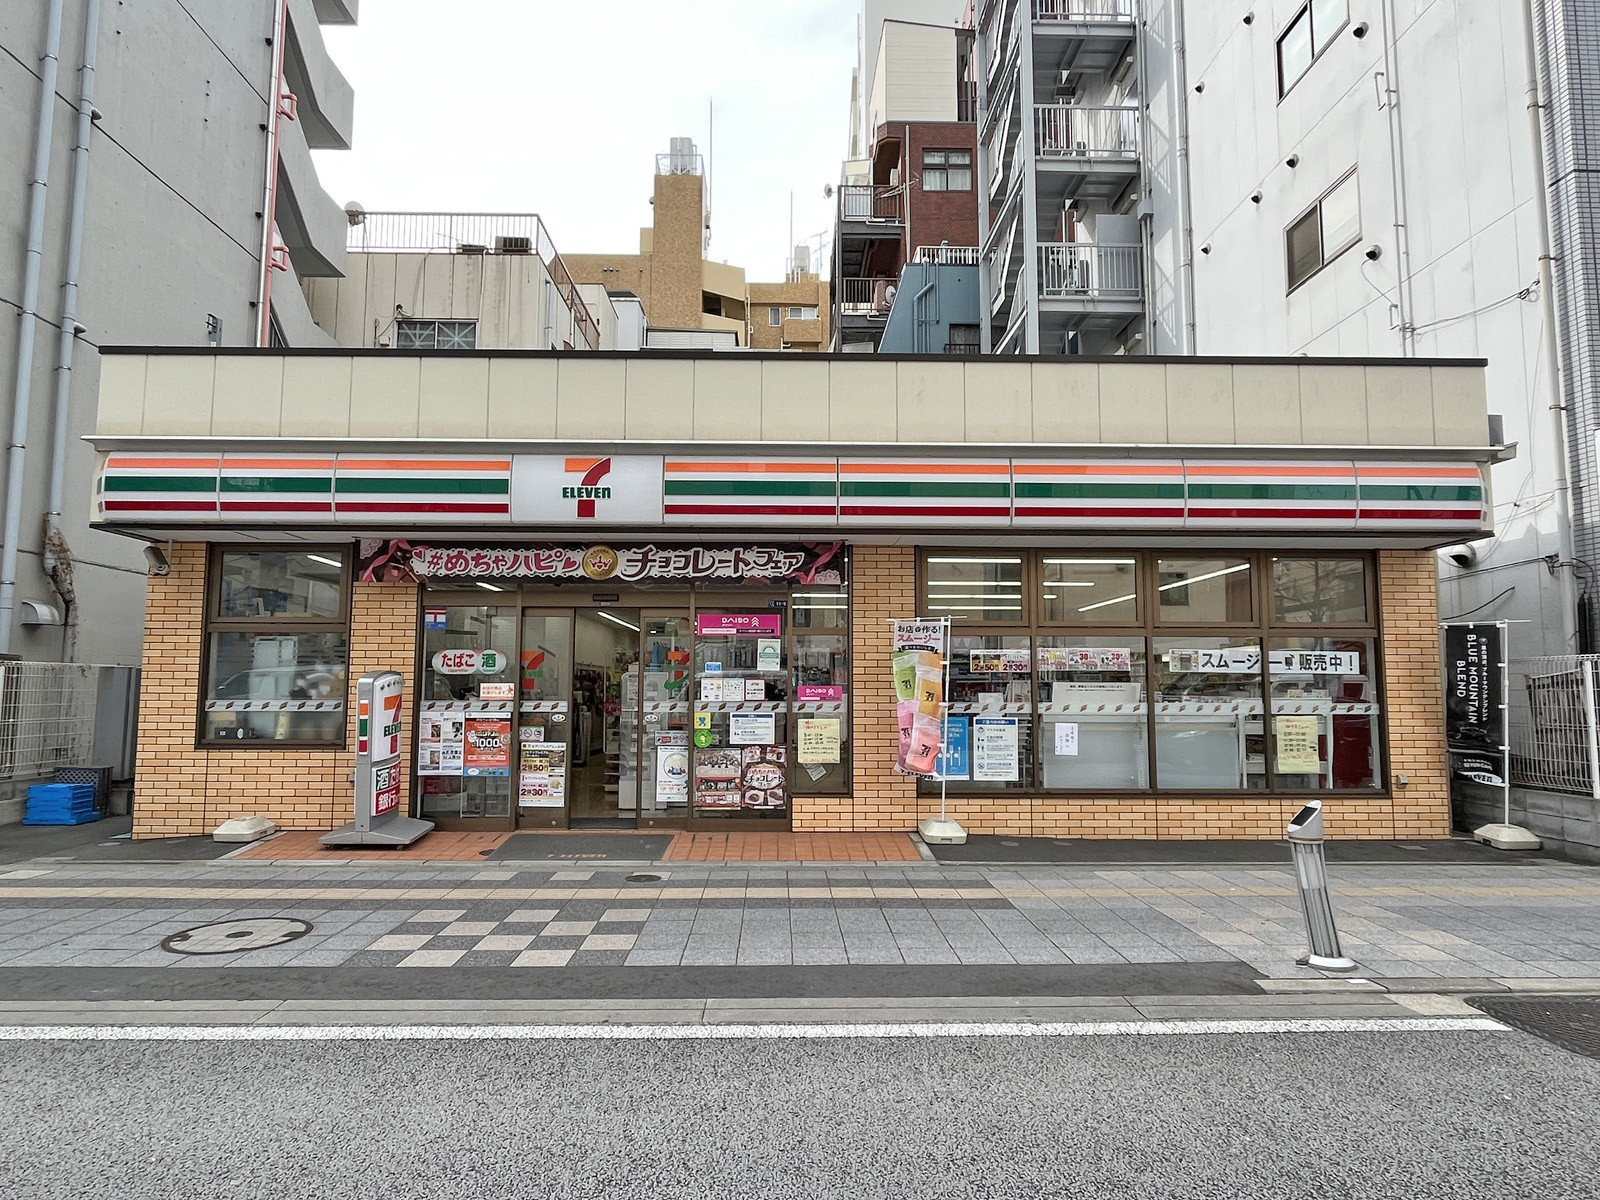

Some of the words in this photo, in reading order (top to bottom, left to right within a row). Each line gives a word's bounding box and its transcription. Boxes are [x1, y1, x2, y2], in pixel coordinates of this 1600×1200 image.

[621, 545, 803, 579] チョコレートフェア
[897, 634, 941, 644] スムージー
[1467, 634, 1477, 663] BLUE
[441, 653, 475, 668] たばこ
[481, 653, 497, 668] 酒
[1457, 660, 1467, 698] BLEND
[1468, 666, 1479, 724] MOUNTAIN
[376, 770, 389, 791] 酒
